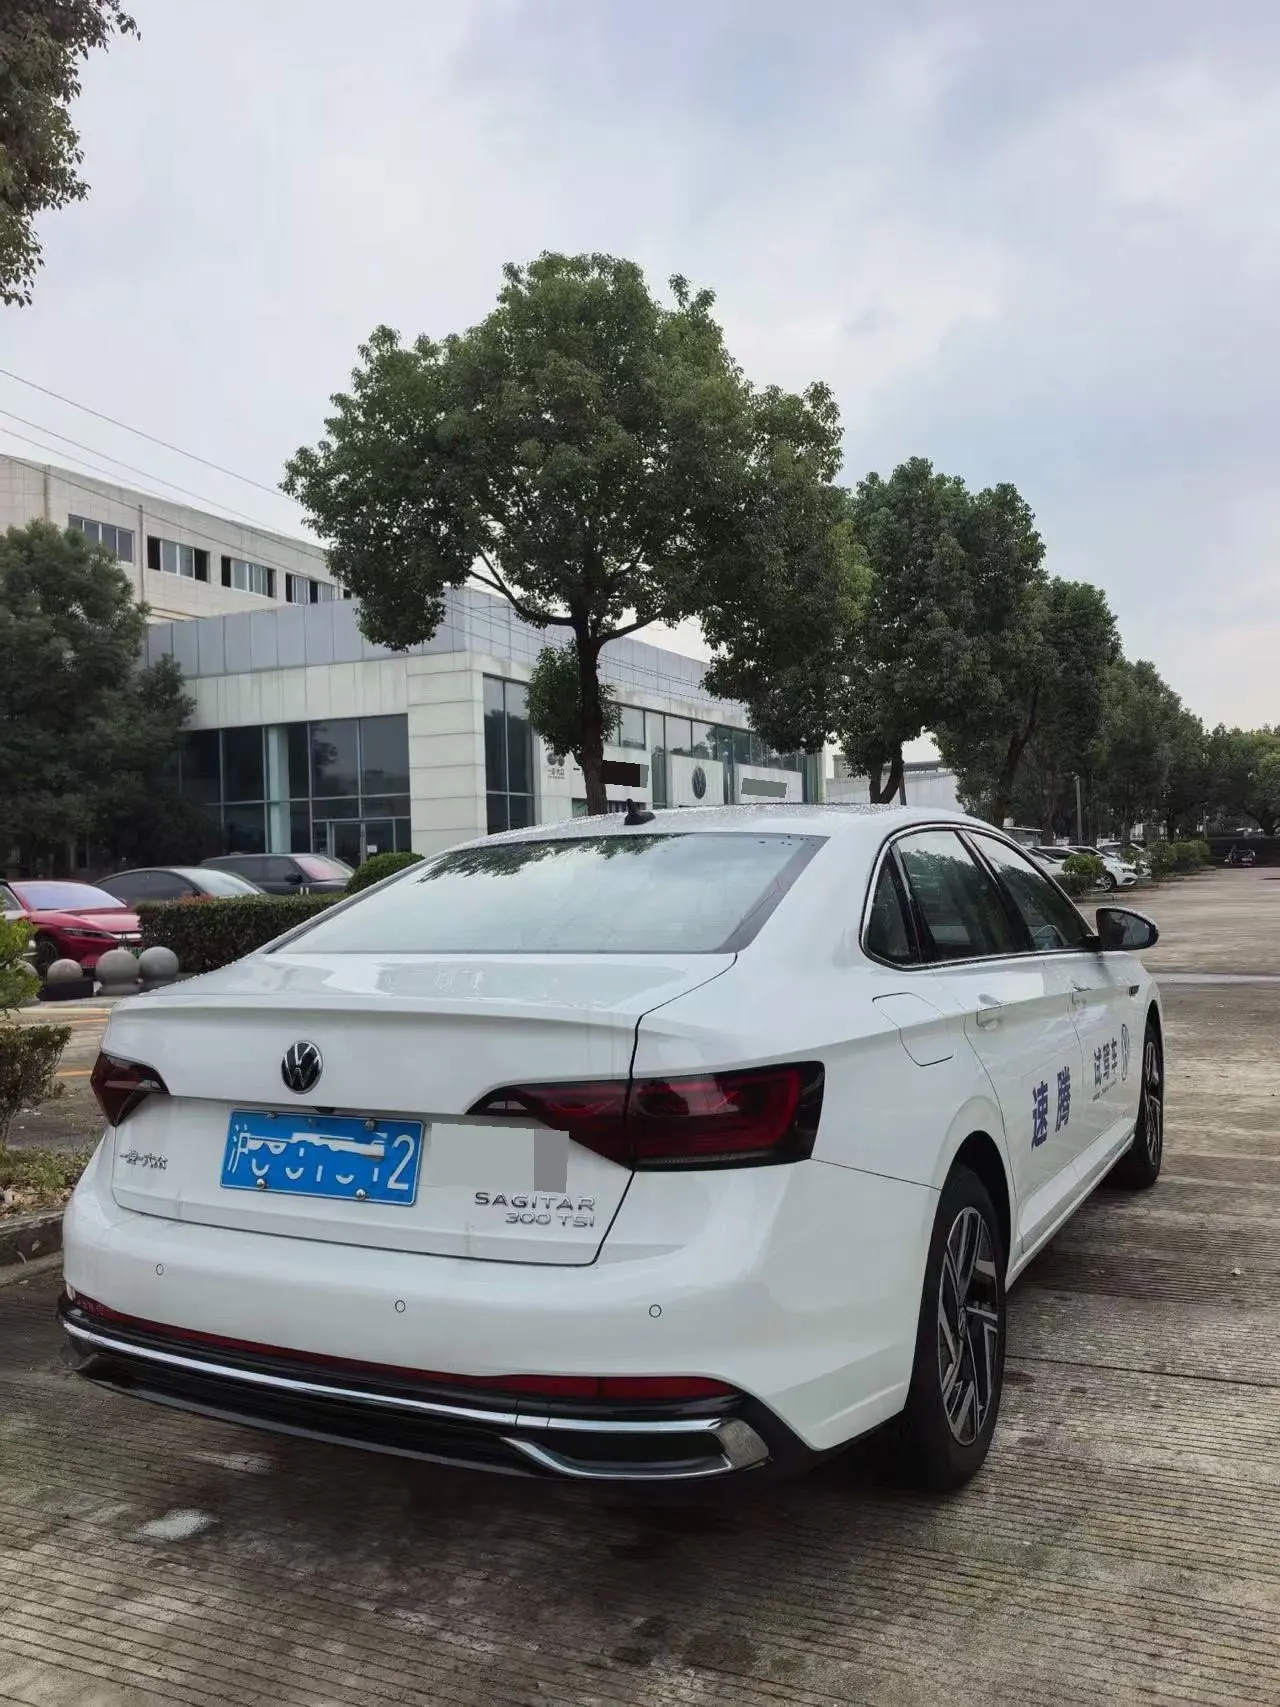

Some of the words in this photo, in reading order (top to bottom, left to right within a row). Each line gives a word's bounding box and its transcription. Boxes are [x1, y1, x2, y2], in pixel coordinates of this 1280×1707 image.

[1031, 1066, 1071, 1151] 速腾
[474, 1191, 596, 1212] SAGITAR
[505, 1211, 552, 1225] 300
[557, 1213, 595, 1228] TSI
